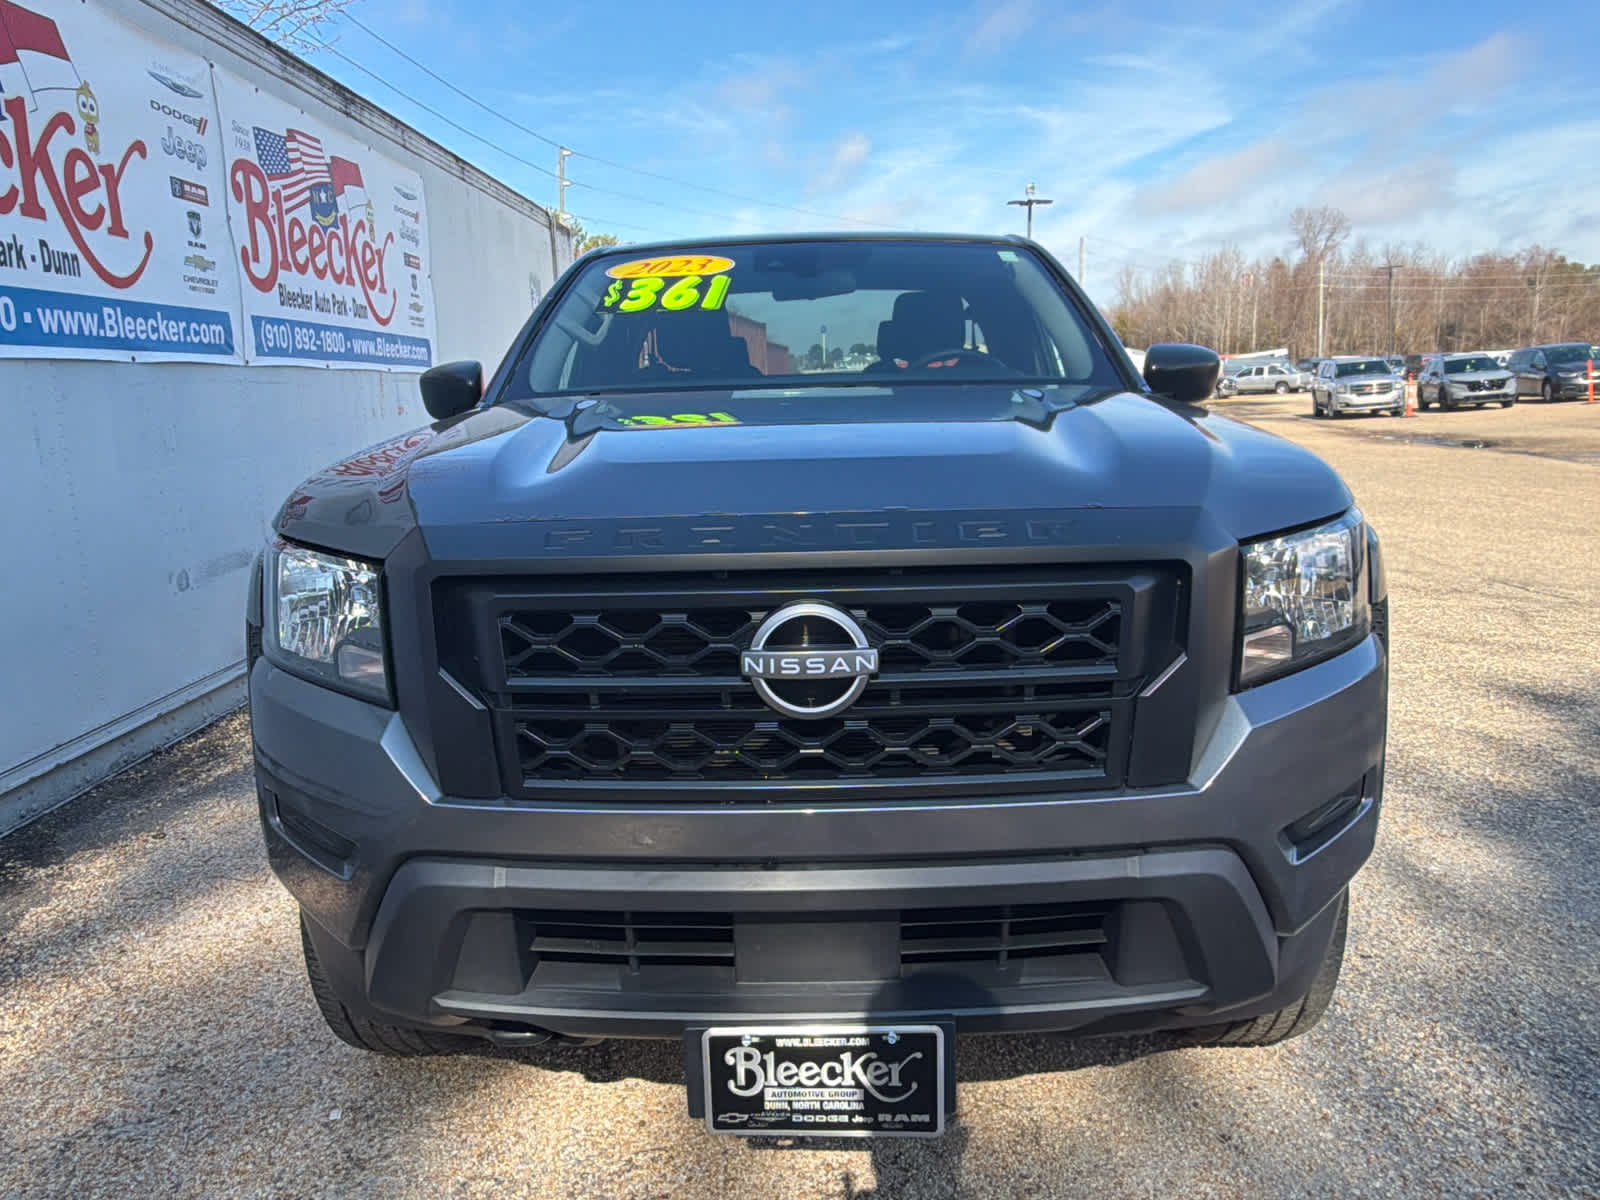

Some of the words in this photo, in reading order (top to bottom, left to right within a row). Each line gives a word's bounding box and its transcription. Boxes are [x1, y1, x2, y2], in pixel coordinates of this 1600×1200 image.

[150, 100, 201, 128] DODGE
[161, 126, 208, 171] Jeep
[38, 238, 81, 278] Dunn
[625, 258, 714, 277] 2023
[278, 283, 312, 312] Bleecker
[315, 290, 331, 314] Auto
[332, 293, 348, 317] Park
[352, 298, 369, 319] Dunn
[603, 275, 731, 312] $361
[36, 306, 225, 345] www.Bleecker.com
[261, 320, 293, 354] (910)
[294, 328, 346, 353] 892-1800
[352, 337, 428, 361] www.Bleecker.com
[544, 519, 1078, 551] FRONTIER
[744, 654, 876, 674] NISSAN
[764, 1101, 791, 1111] DUNN,
[792, 1101, 821, 1111] NORTH
[822, 1101, 864, 1111] CAROLINA
[771, 1090, 825, 1099] AUTOMOTIVE
[828, 1090, 858, 1099] GROUP
[792, 1114, 849, 1123] DODGE
[878, 1113, 930, 1122] RAM
